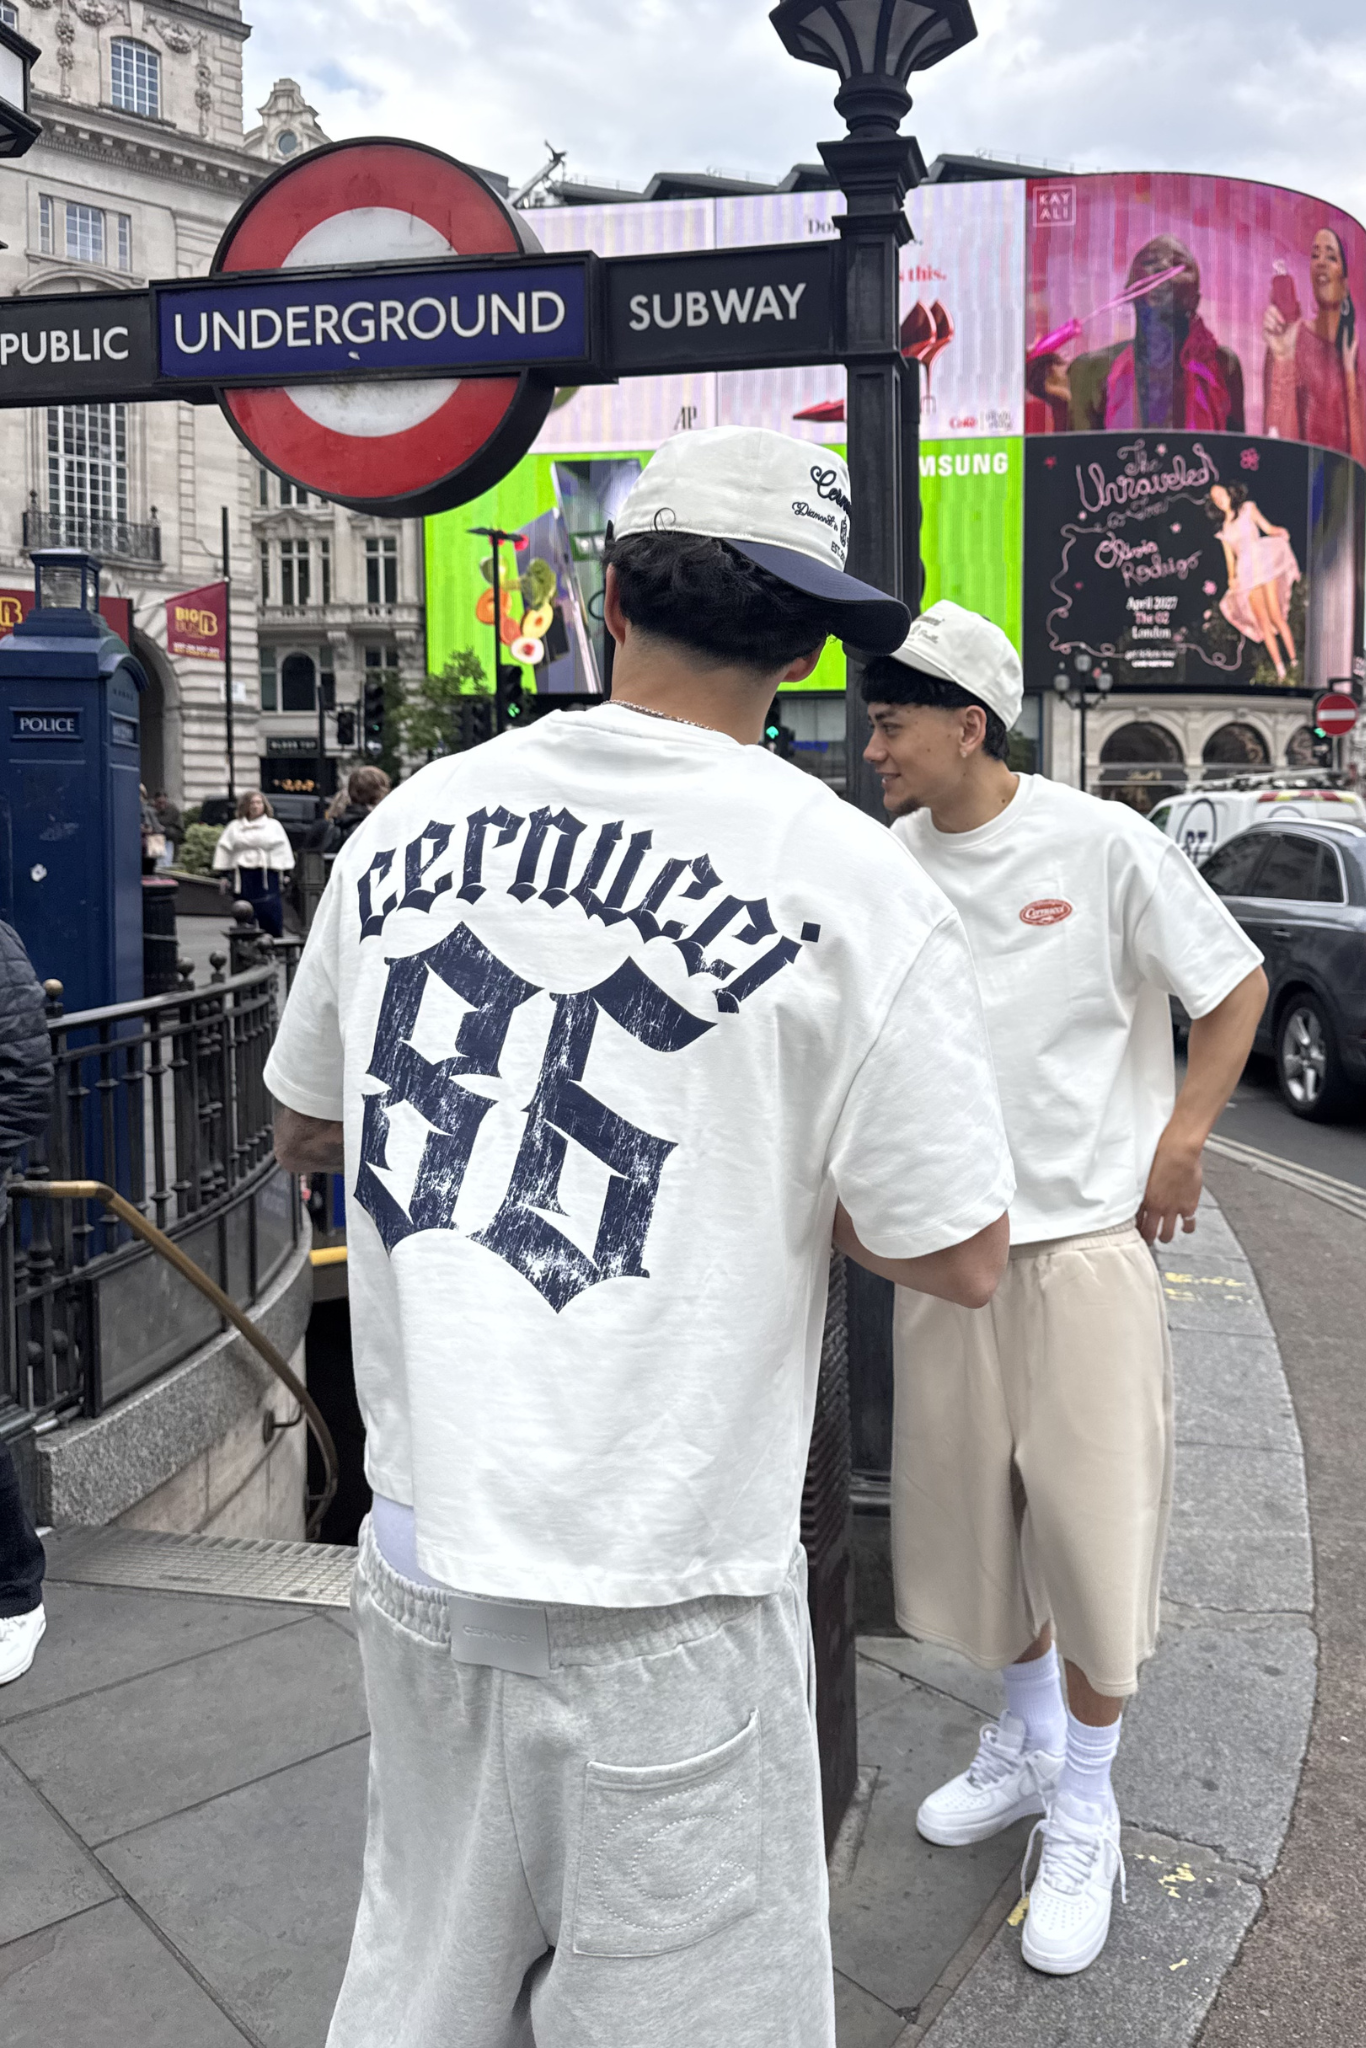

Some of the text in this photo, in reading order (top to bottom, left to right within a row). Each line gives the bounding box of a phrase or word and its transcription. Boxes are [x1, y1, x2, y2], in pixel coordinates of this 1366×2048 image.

[1040, 192, 1070, 205] KAY
[1040, 208, 1069, 220] ALI
[629, 283, 806, 331] SUBWAY
[175, 290, 566, 356] UNDERGROUND
[0, 326, 130, 366] PUBLIC
[919, 452, 1009, 477] MSUNG
[1126, 596, 1153, 610] April
[1132, 626, 1171, 639] London
[20, 716, 75, 733] POLICE
